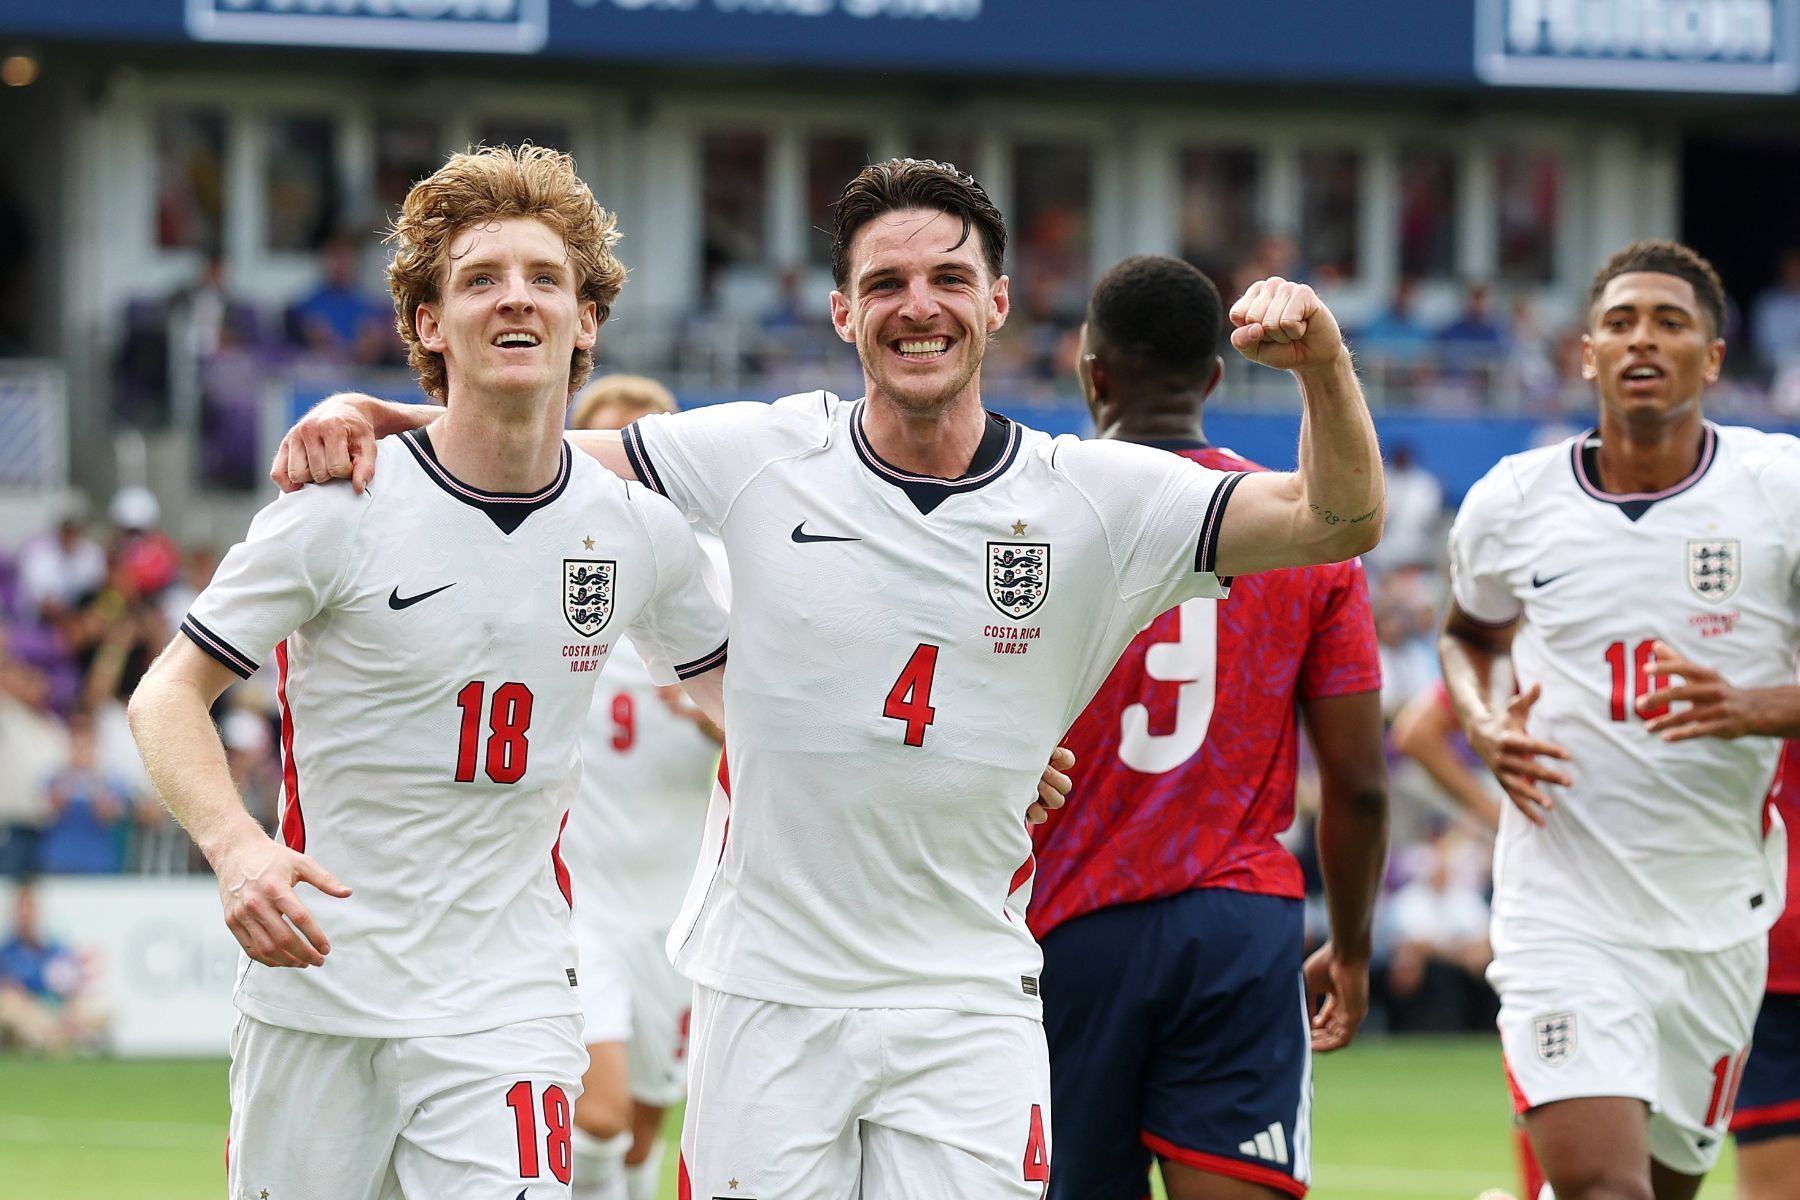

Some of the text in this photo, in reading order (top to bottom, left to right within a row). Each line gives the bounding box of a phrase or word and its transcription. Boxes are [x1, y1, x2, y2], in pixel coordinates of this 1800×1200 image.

[562, 644, 608, 657] COSTA RICA
[984, 625, 1040, 640] COSTA RICA
[993, 641, 1028, 654] 10.06.26
[610, 692, 635, 752] 9
[882, 643, 939, 748] 4
[1605, 639, 1671, 722] 10
[454, 680, 534, 784] 18
[506, 1081, 572, 1186] 18
[1023, 1104, 1049, 1199] 4
